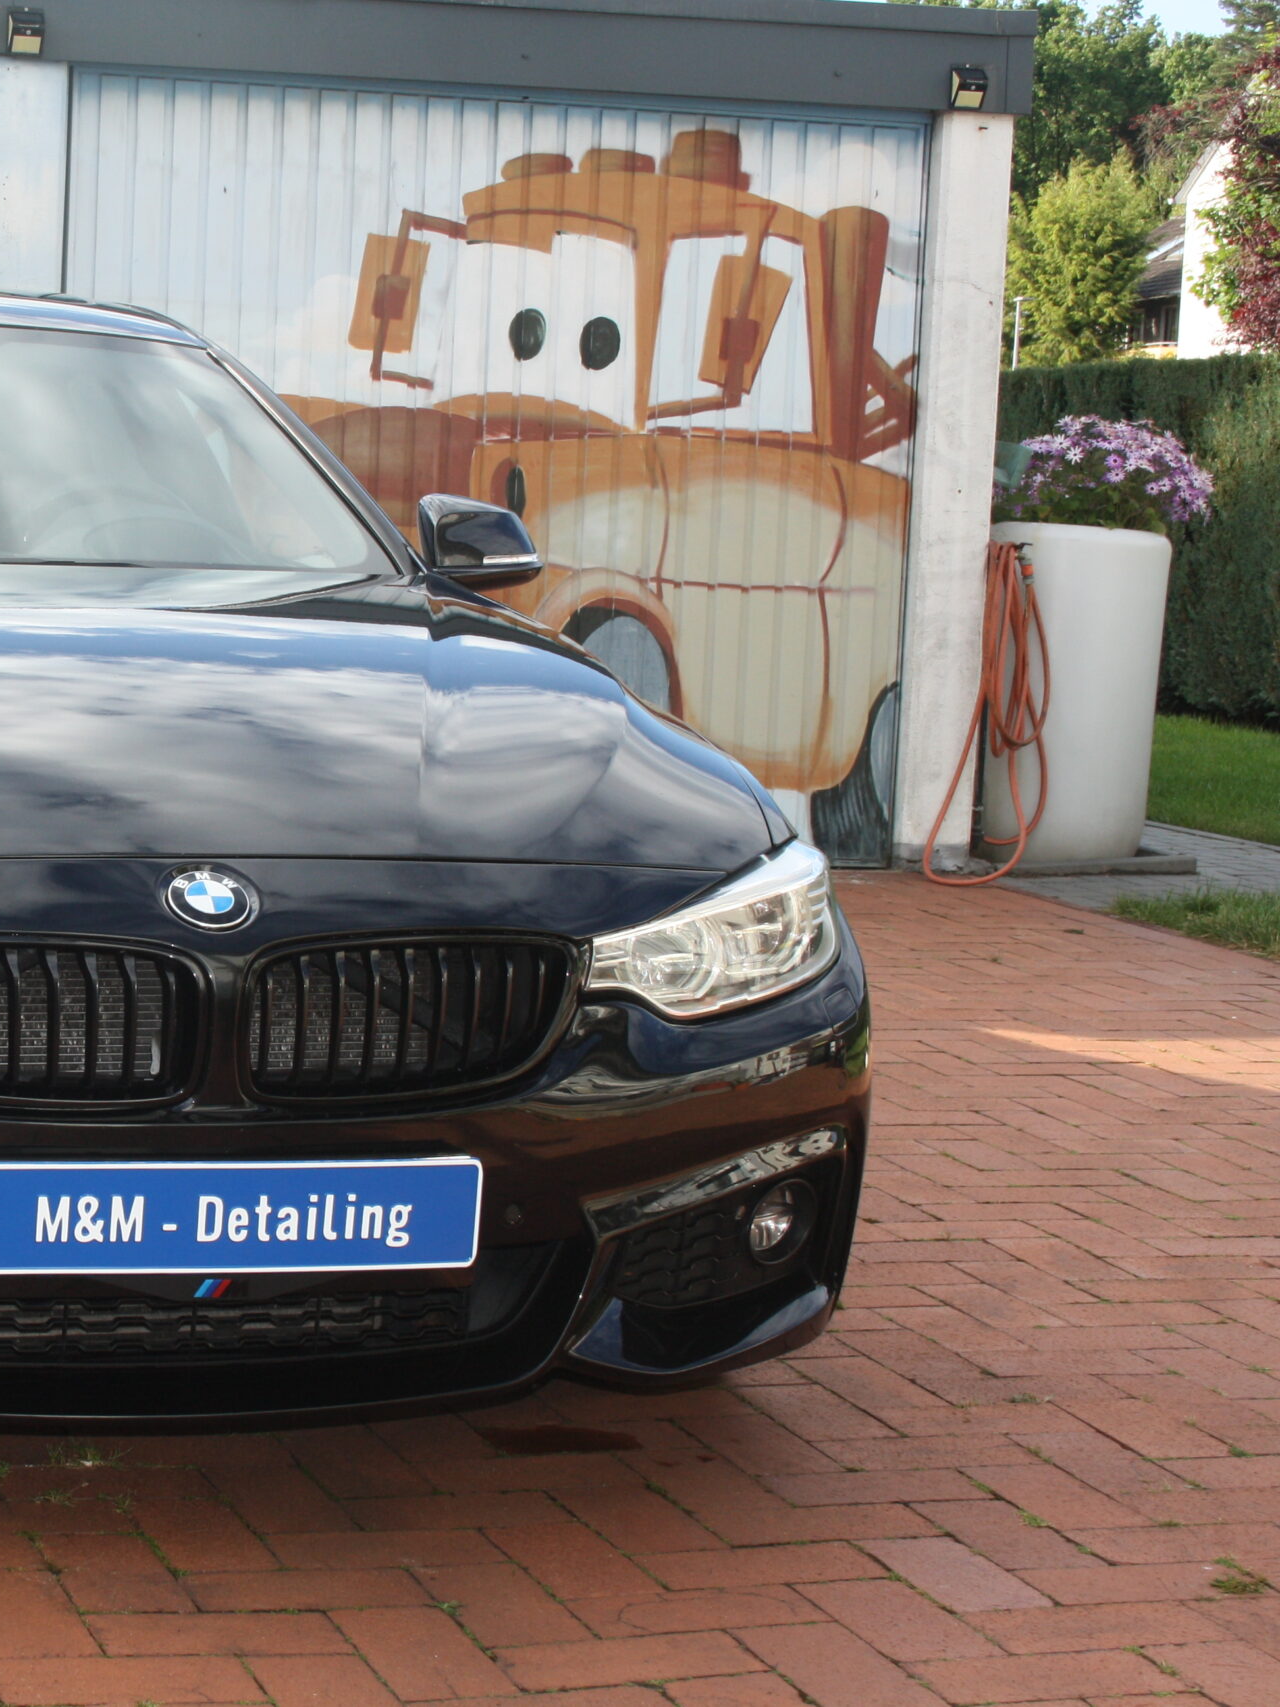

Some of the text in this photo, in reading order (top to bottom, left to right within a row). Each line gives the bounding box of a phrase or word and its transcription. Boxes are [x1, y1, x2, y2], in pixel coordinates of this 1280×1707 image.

[173, 872, 238, 889] BMW
[35, 1195, 145, 1243] M&M
[196, 1194, 413, 1248] Detailing
